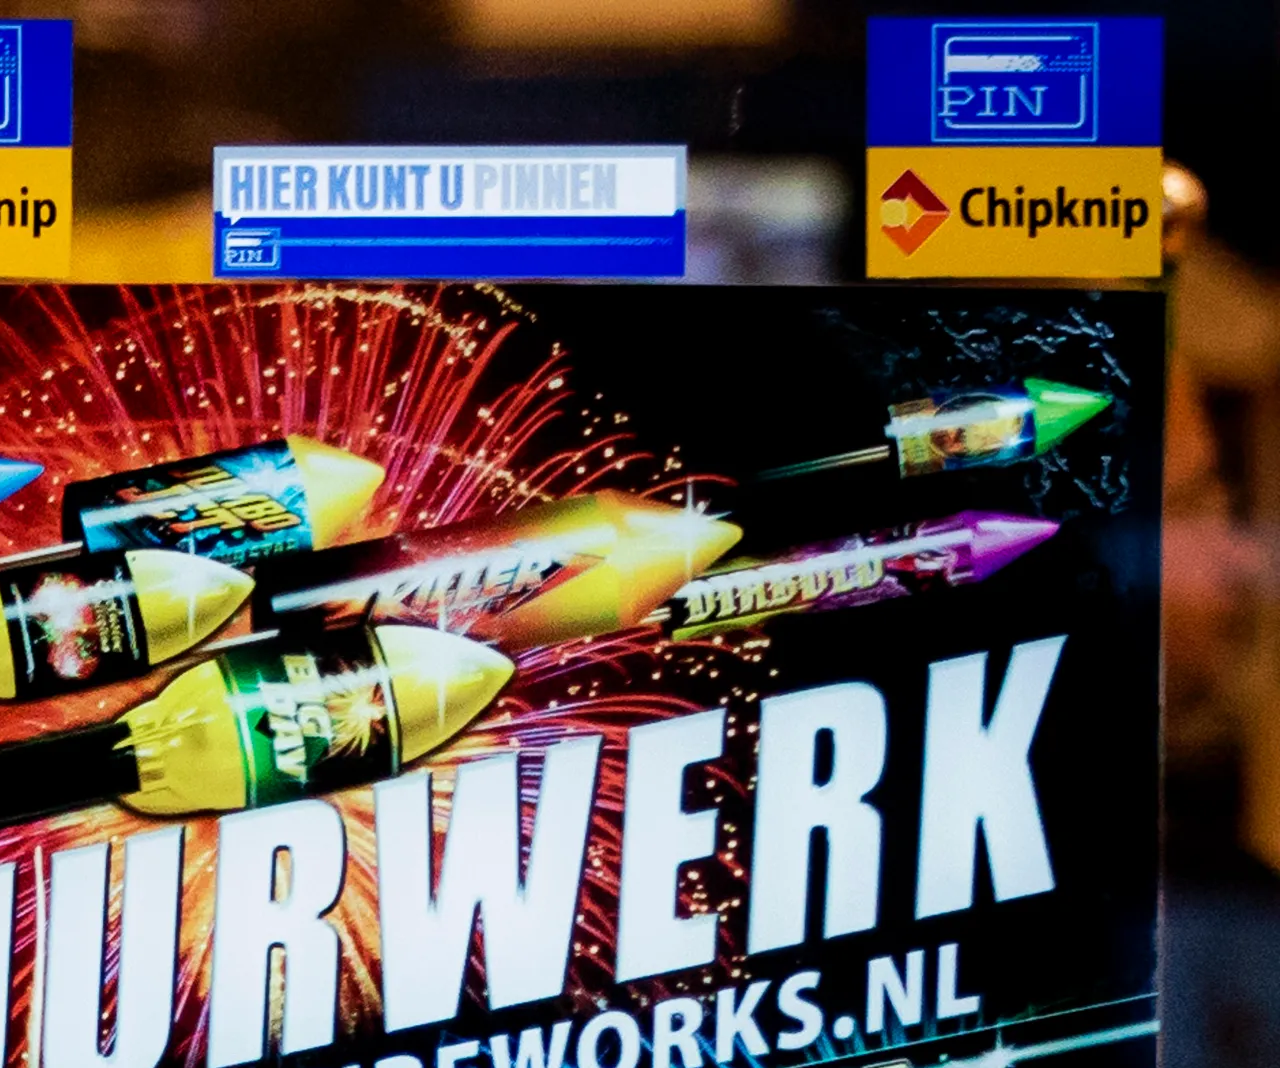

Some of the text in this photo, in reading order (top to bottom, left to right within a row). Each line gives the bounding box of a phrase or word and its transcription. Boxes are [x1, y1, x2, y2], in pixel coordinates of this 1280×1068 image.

[938, 85, 1049, 117] PIN
[229, 162, 618, 211] HIER KUNT U PINNEN
[959, 185, 1150, 239] Chipknip
[223, 249, 264, 264] PIN
